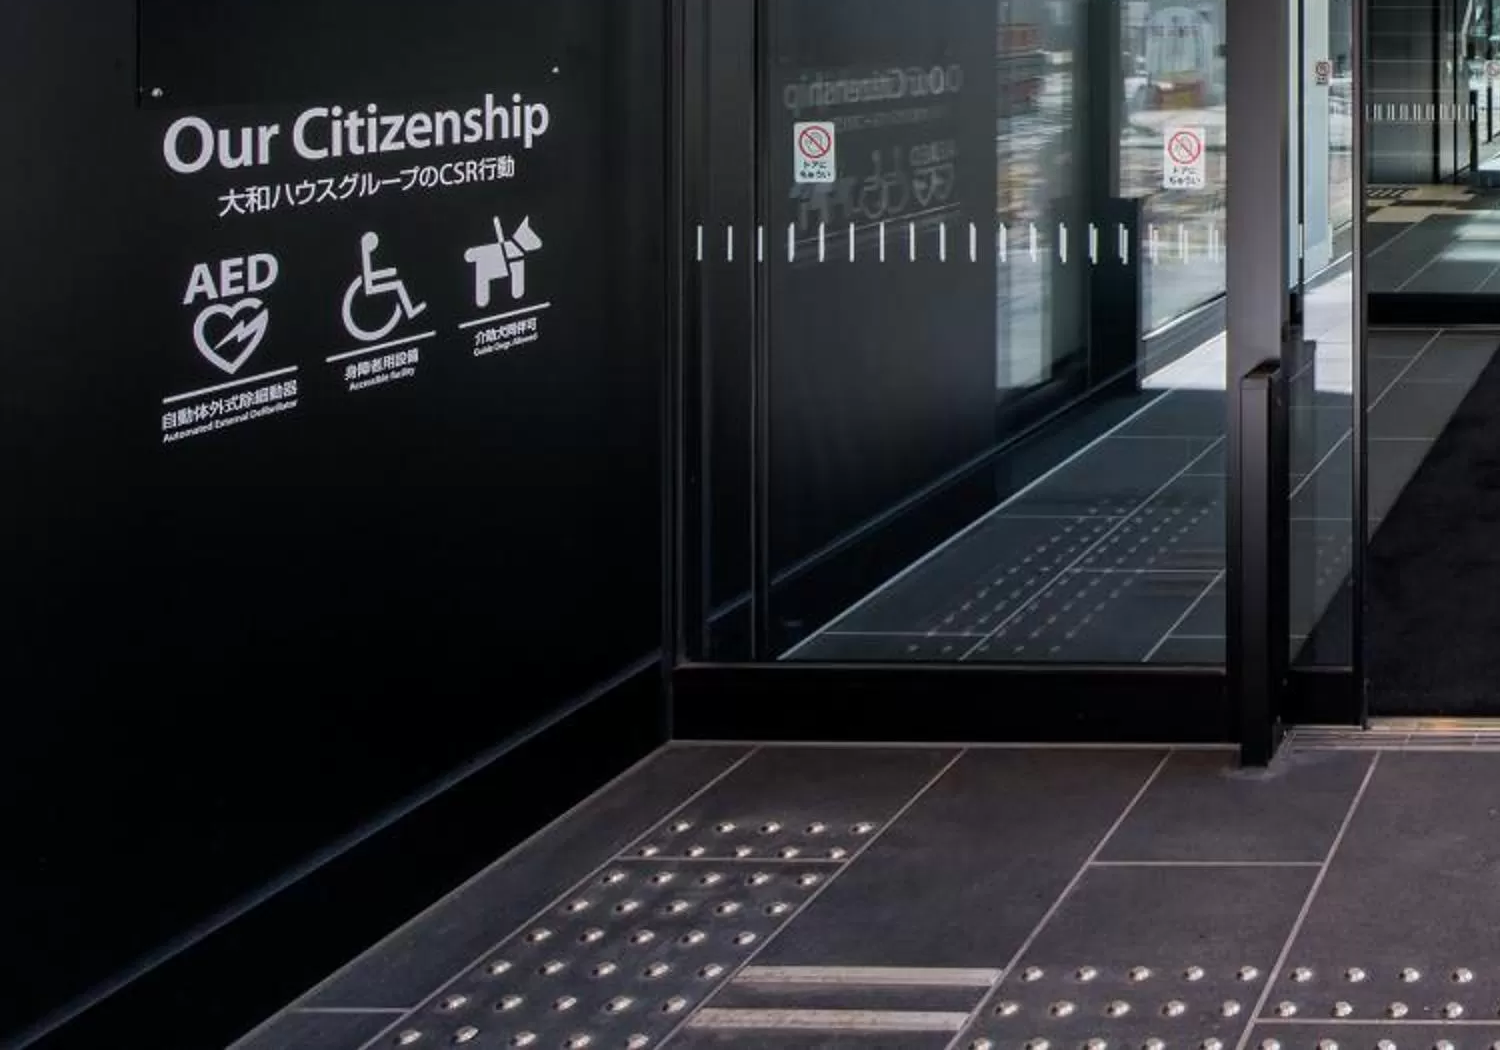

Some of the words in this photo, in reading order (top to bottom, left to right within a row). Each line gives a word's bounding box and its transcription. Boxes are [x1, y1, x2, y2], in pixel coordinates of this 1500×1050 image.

[163, 115, 280, 174] Our
[293, 93, 549, 159] Citizenship
[218, 154, 515, 218] 大和ハウスグループのCSR行動
[183, 253, 279, 305] AED
[162, 379, 298, 431] 自動体外式除細動器
